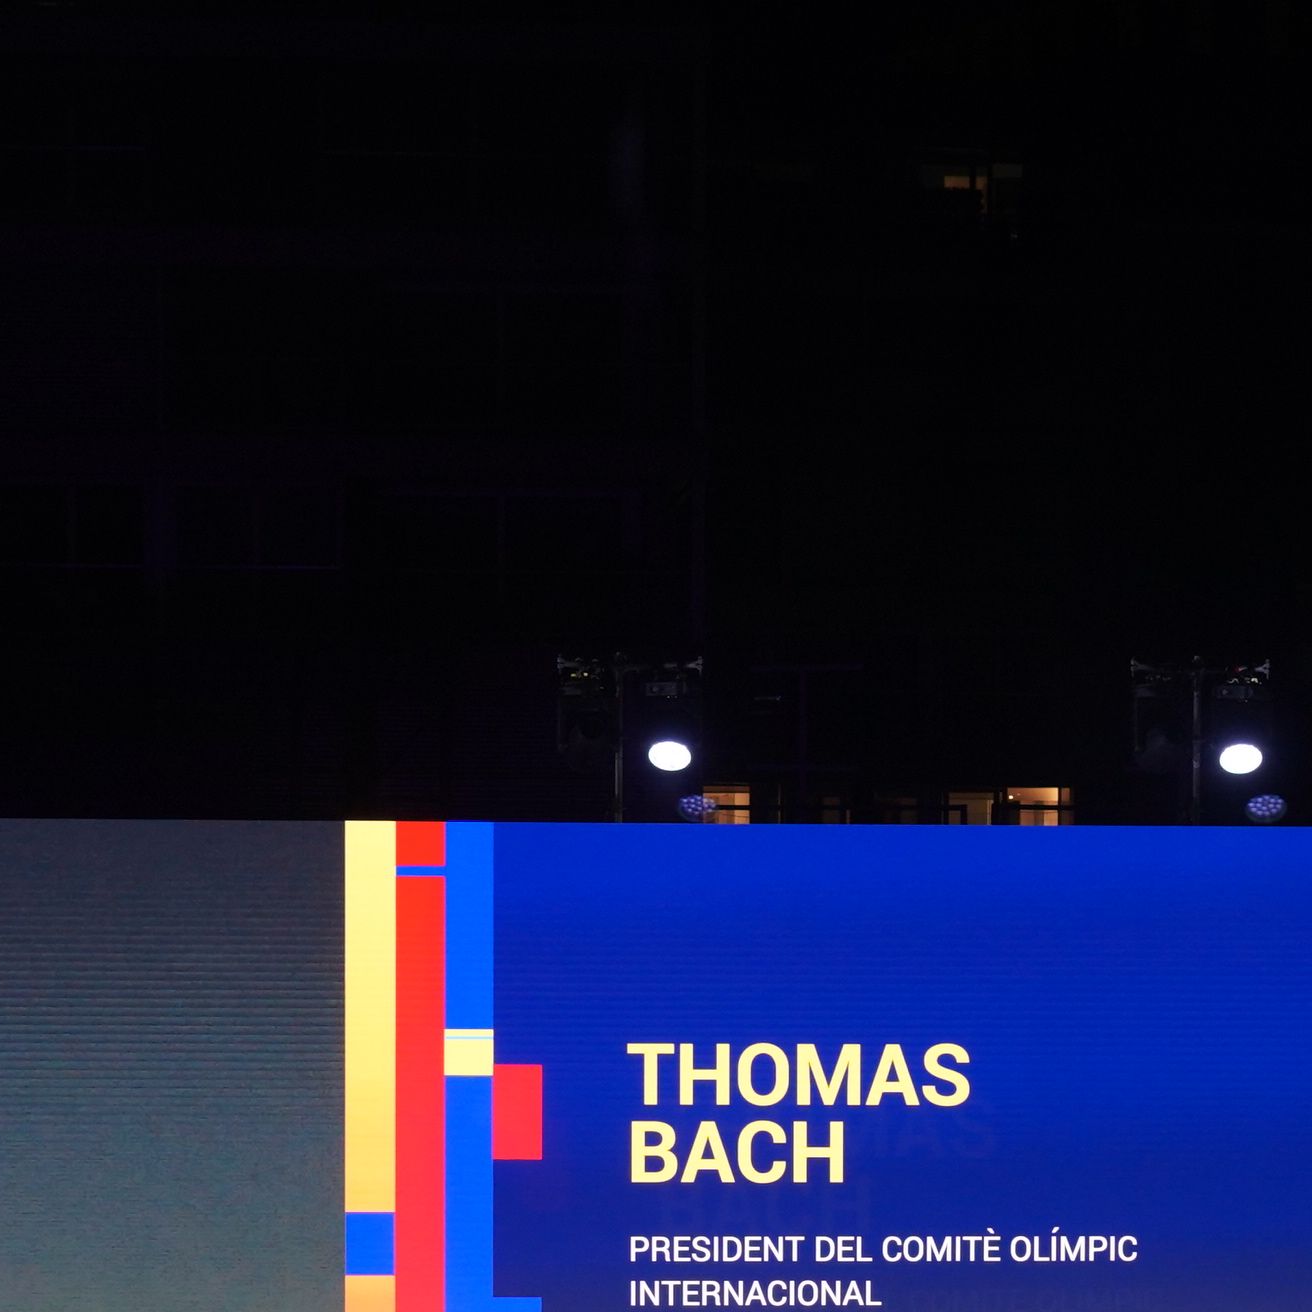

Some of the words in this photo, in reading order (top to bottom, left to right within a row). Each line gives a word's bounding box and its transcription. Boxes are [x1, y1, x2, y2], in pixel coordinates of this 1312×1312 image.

[626, 1042, 971, 1107] THOMAS
[630, 1119, 844, 1184] BACH
[630, 1235, 806, 1263] PRESIDENT
[815, 1235, 873, 1262] DEL
[882, 1227, 1002, 1263] COMITÈ
[1010, 1226, 1138, 1262] OLÍMPIC
[630, 1279, 883, 1307] INTERNACIONAL
